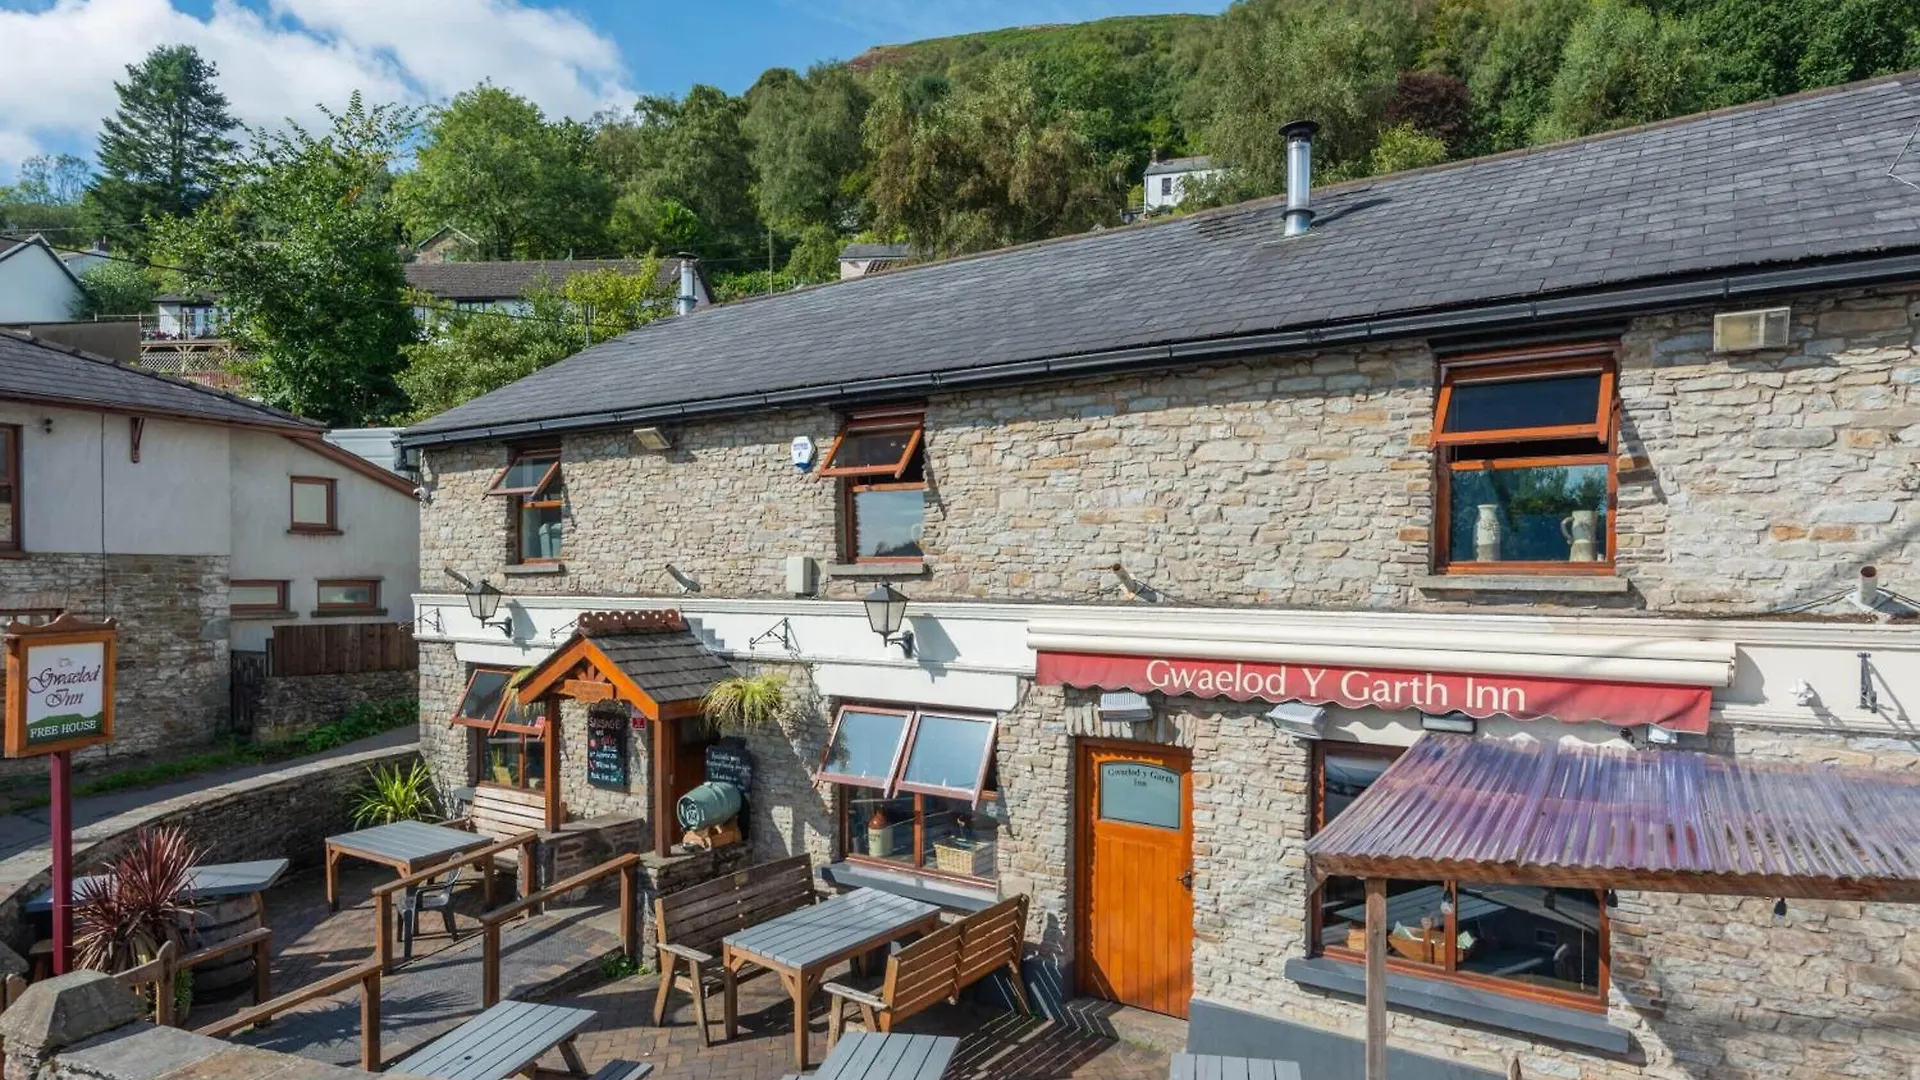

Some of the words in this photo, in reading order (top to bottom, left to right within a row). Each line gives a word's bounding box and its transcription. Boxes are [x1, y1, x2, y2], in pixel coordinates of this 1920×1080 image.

[28, 664, 101, 694] Gwaelod
[1145, 659, 1286, 696] Gwaelod
[1302, 667, 1327, 698] Y
[1341, 670, 1448, 707] Garth
[1466, 676, 1525, 712] Inn
[45, 688, 84, 708] Inn
[30, 725, 59, 738] FREE
[61, 720, 96, 734] HOUSE
[1107, 768, 1140, 777] Gwaelod
[1150, 770, 1175, 784] Garth
